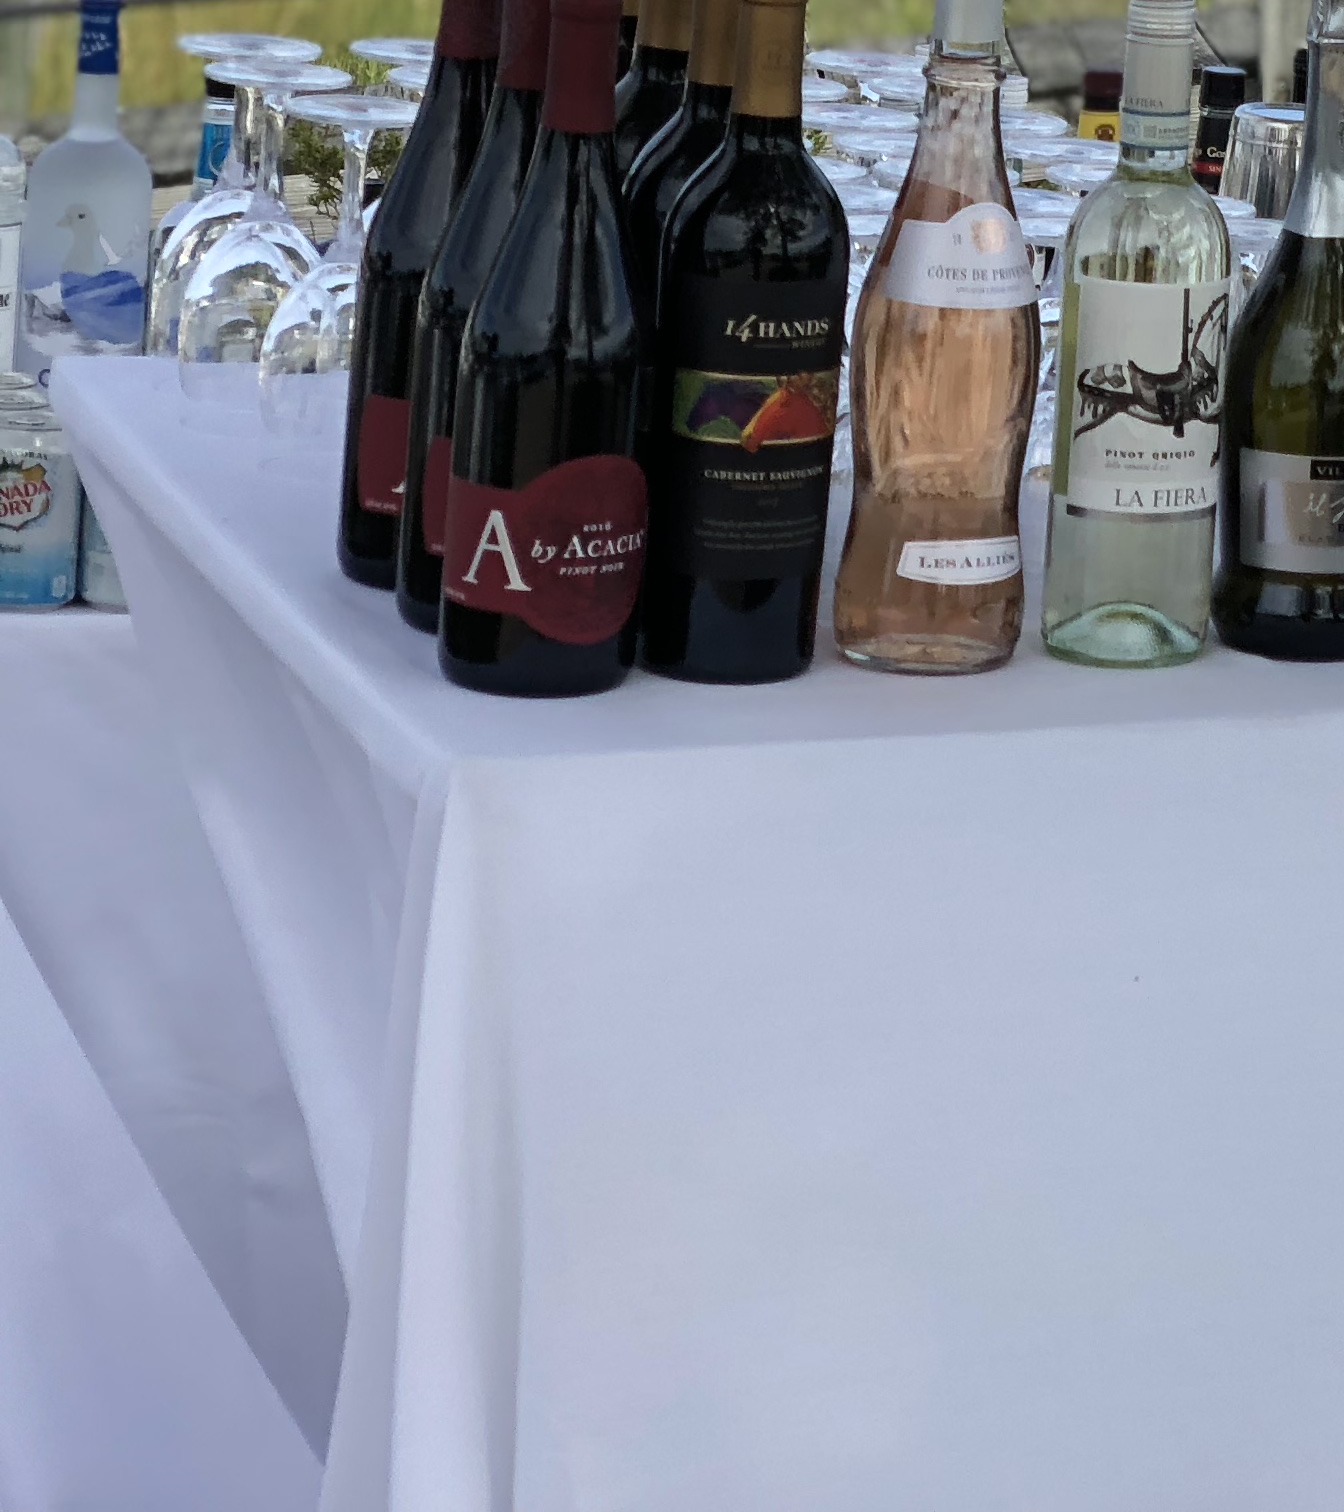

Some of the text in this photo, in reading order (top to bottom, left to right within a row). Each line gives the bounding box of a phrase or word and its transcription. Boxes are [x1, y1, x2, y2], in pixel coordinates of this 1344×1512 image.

[927, 264, 967, 281] CÔTES
[972, 268, 989, 281] DE
[724, 313, 829, 343] 14 HANDS
[1105, 449, 1195, 460] PINOT GRIGIO
[704, 469, 767, 481] CABERNET
[0, 480, 52, 500] NADA
[1115, 486, 1207, 508] LA FIERA
[462, 509, 642, 592] A by ACACIA
[918, 555, 957, 569] LES
